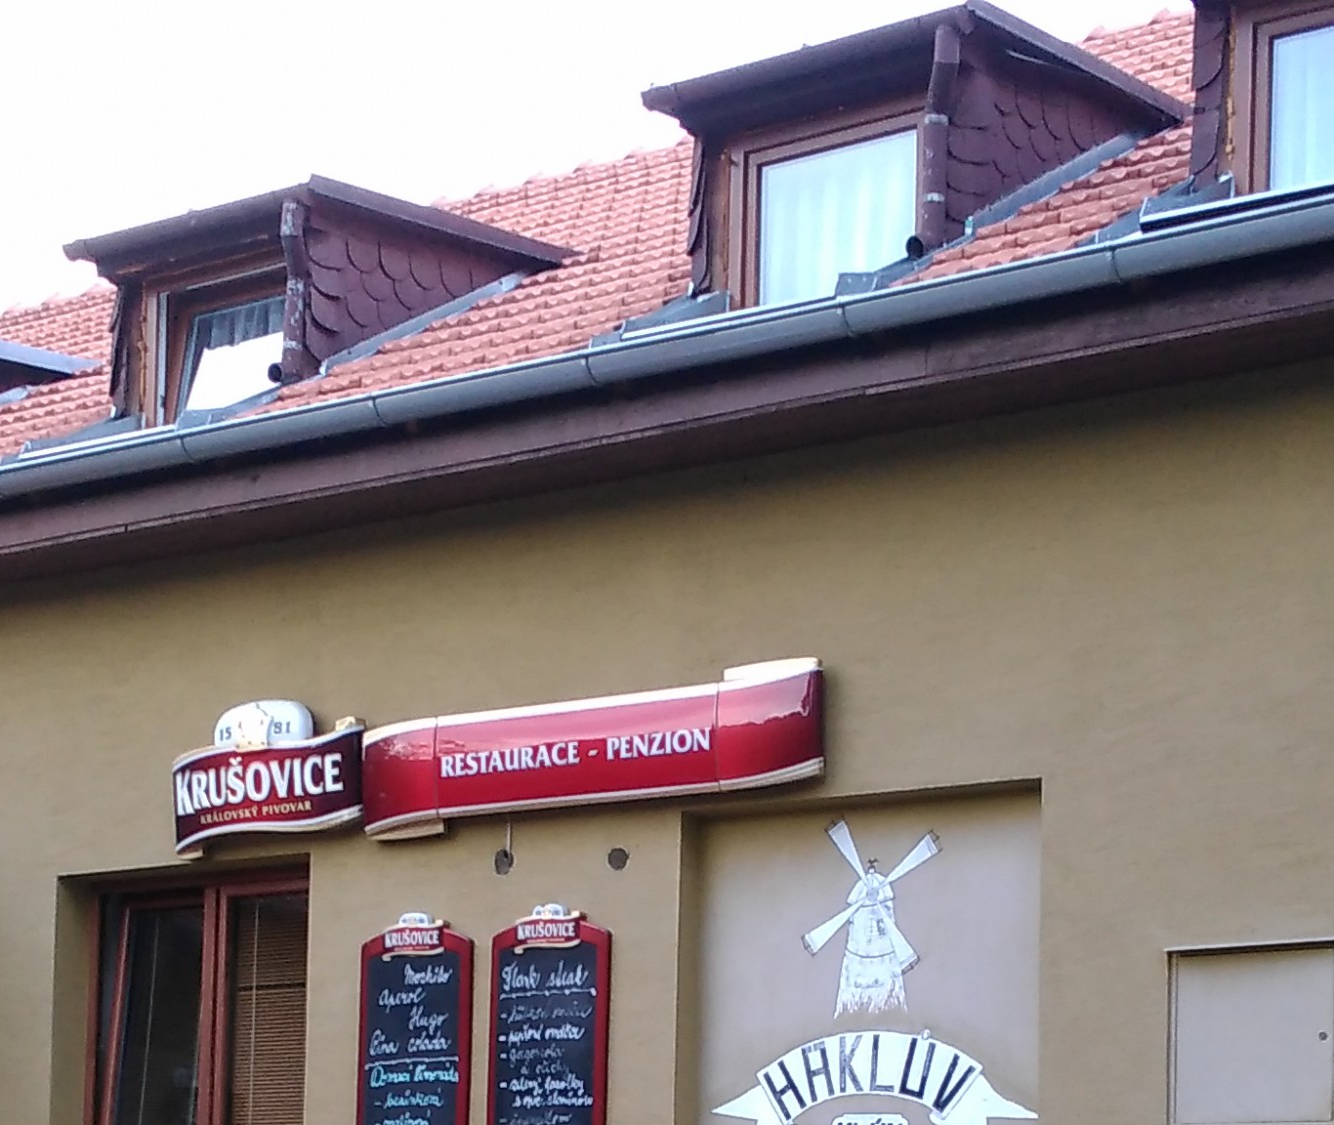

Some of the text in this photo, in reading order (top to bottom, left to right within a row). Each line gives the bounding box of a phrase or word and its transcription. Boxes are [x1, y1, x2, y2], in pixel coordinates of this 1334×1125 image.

[219, 721, 292, 742] 15 81
[440, 741, 580, 778] RESTAURACE
[606, 727, 711, 761] PENZION
[175, 752, 344, 817] KRUŠOVICE
[200, 800, 312, 825] KRÁLOVSKÝ PIVOVAR
[384, 929, 440, 948] KRUŠOVICE
[517, 920, 575, 941] KRUŠOVICE
